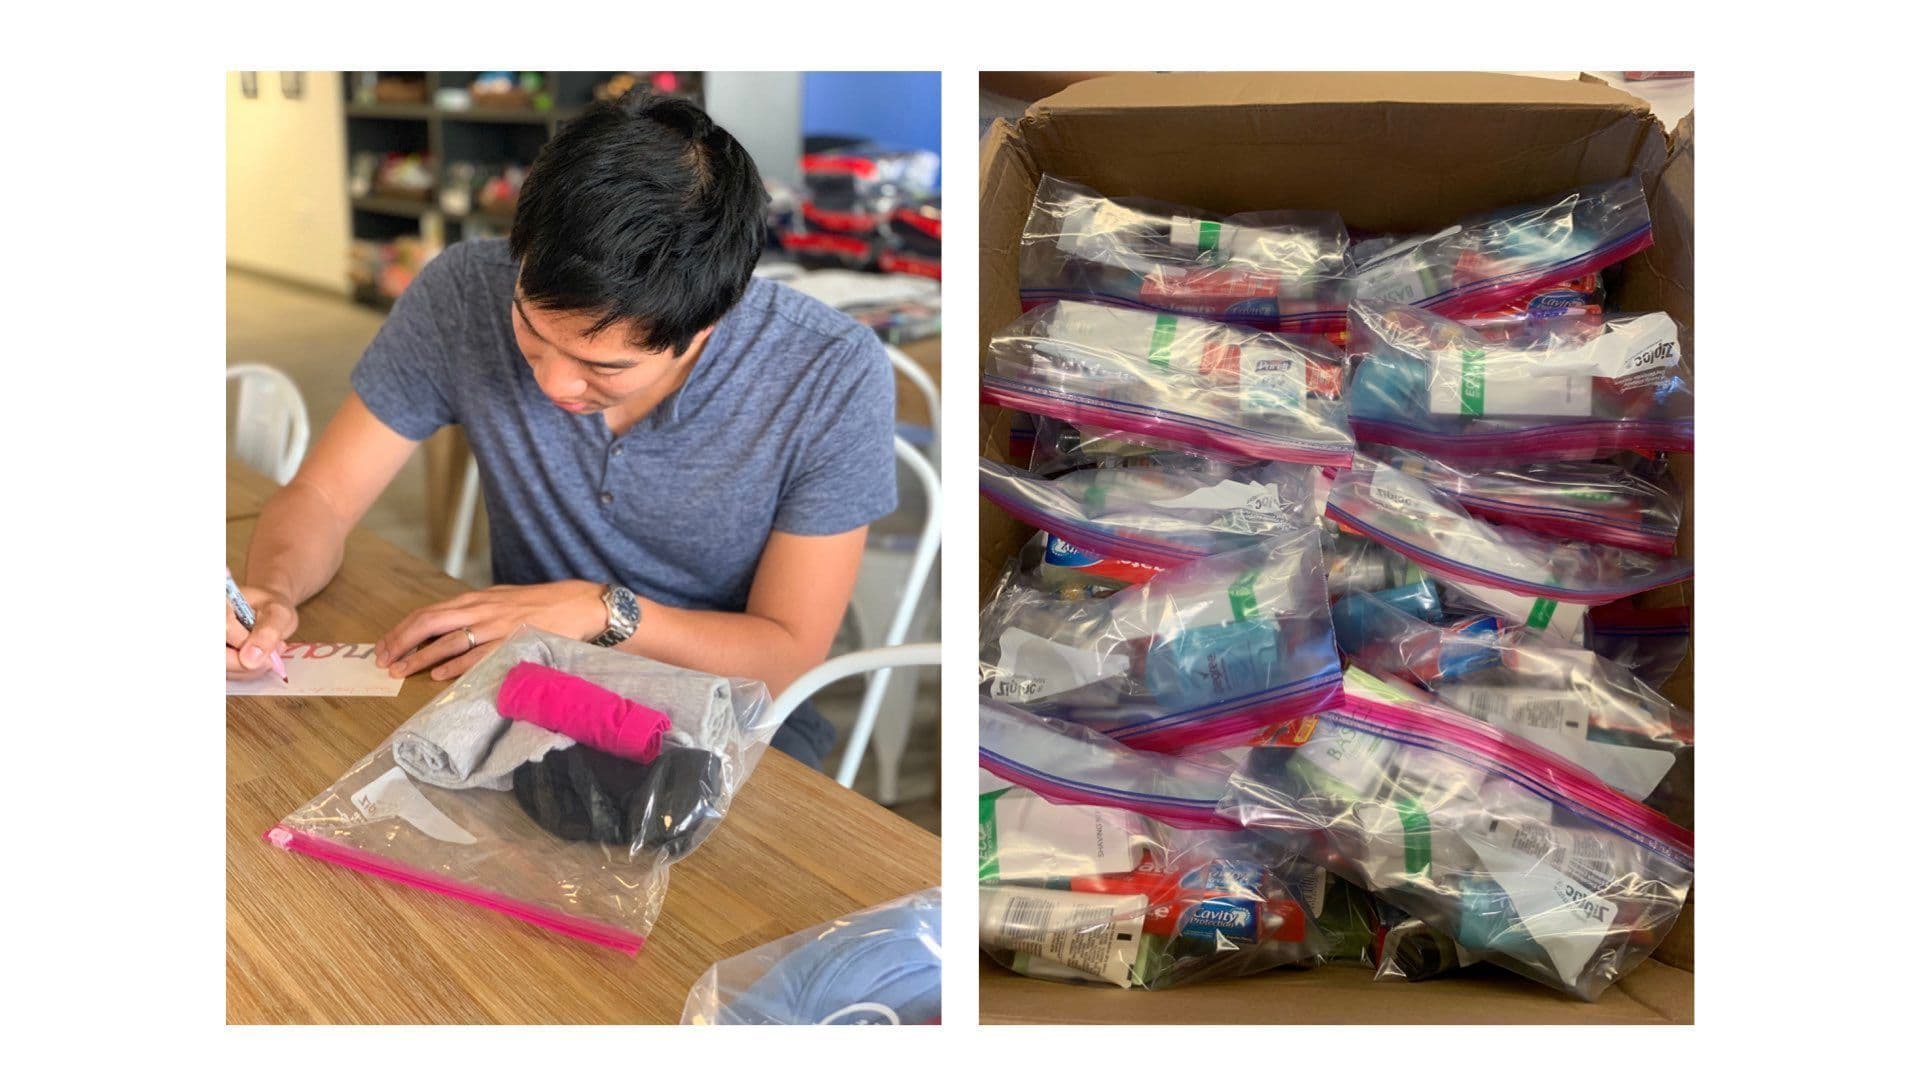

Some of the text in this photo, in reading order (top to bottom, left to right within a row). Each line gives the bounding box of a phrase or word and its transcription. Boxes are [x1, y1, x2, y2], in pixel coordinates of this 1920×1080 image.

[1633, 341, 1675, 367] Ziploc
[1190, 916, 1235, 928] Protection
[1193, 906, 1238, 924] Cavity
